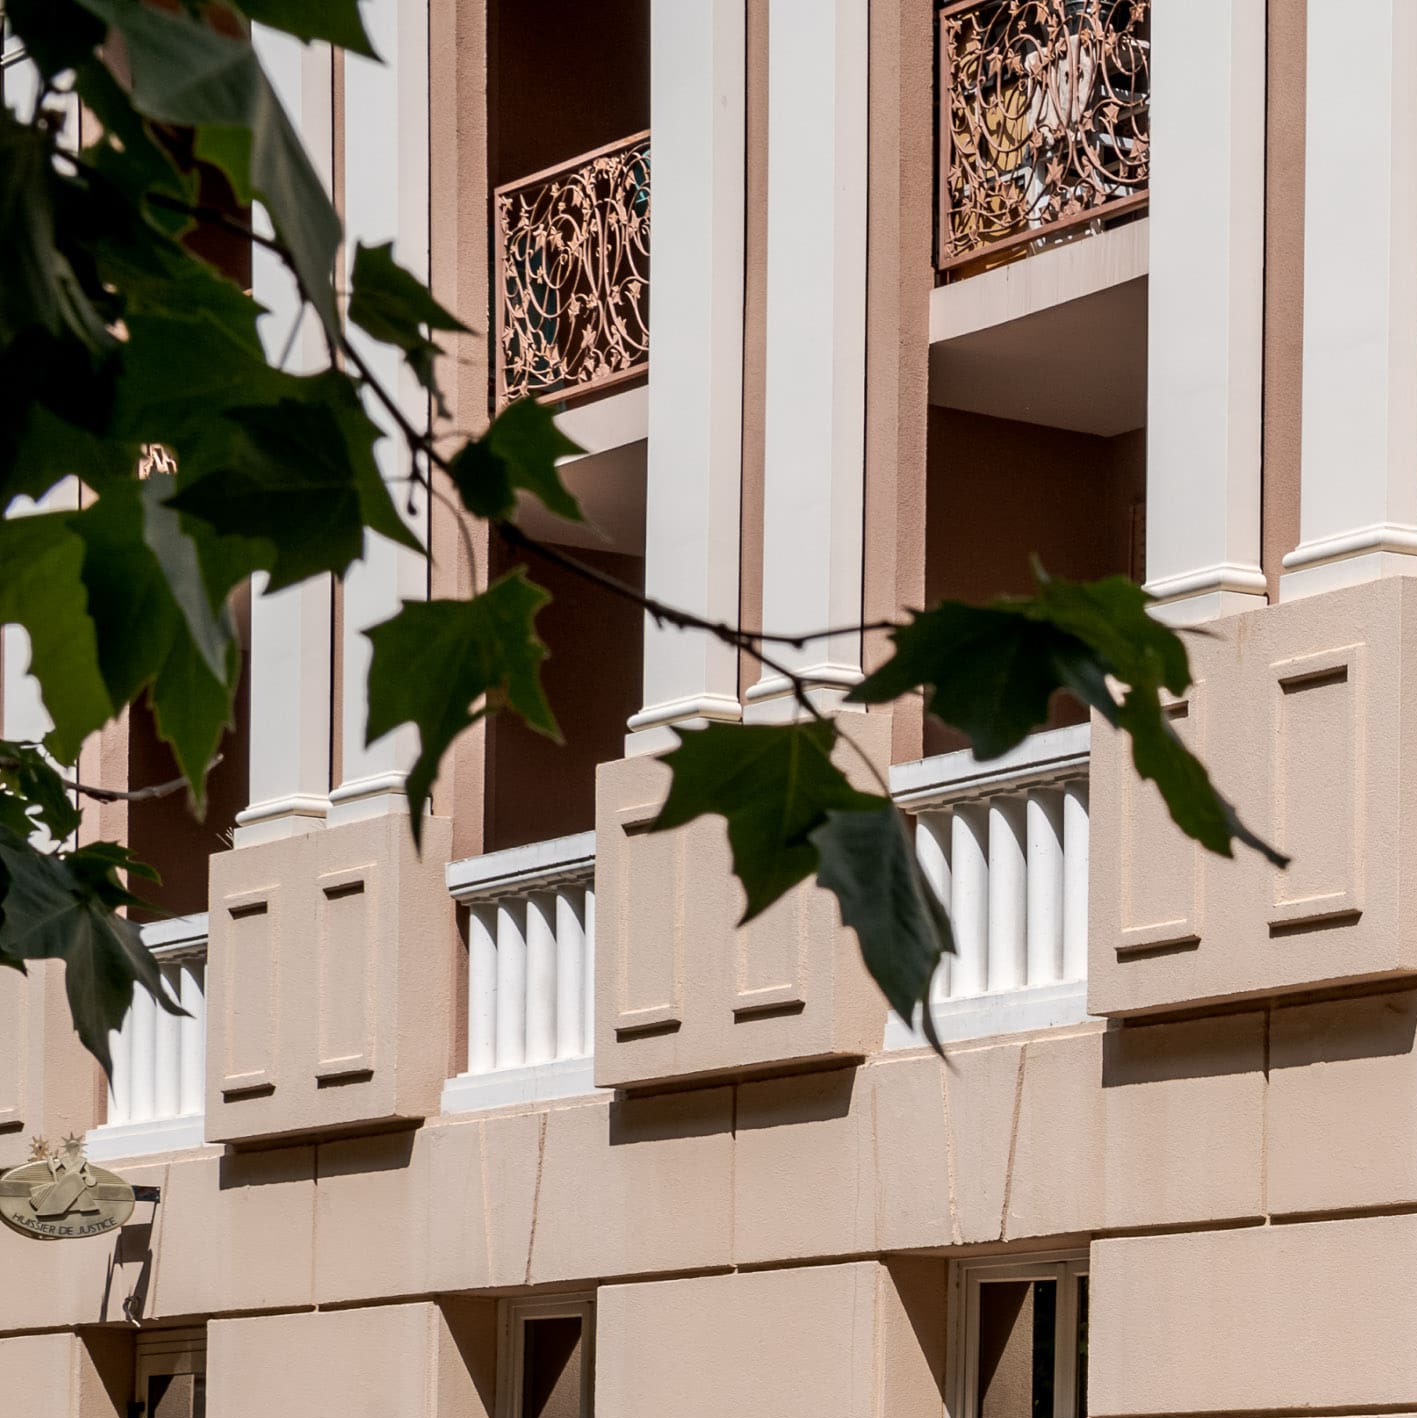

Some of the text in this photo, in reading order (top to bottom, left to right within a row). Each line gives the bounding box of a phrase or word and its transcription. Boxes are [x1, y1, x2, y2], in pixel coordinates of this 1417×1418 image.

[12, 1213, 118, 1235] HUISSIER DE JUSTICE
